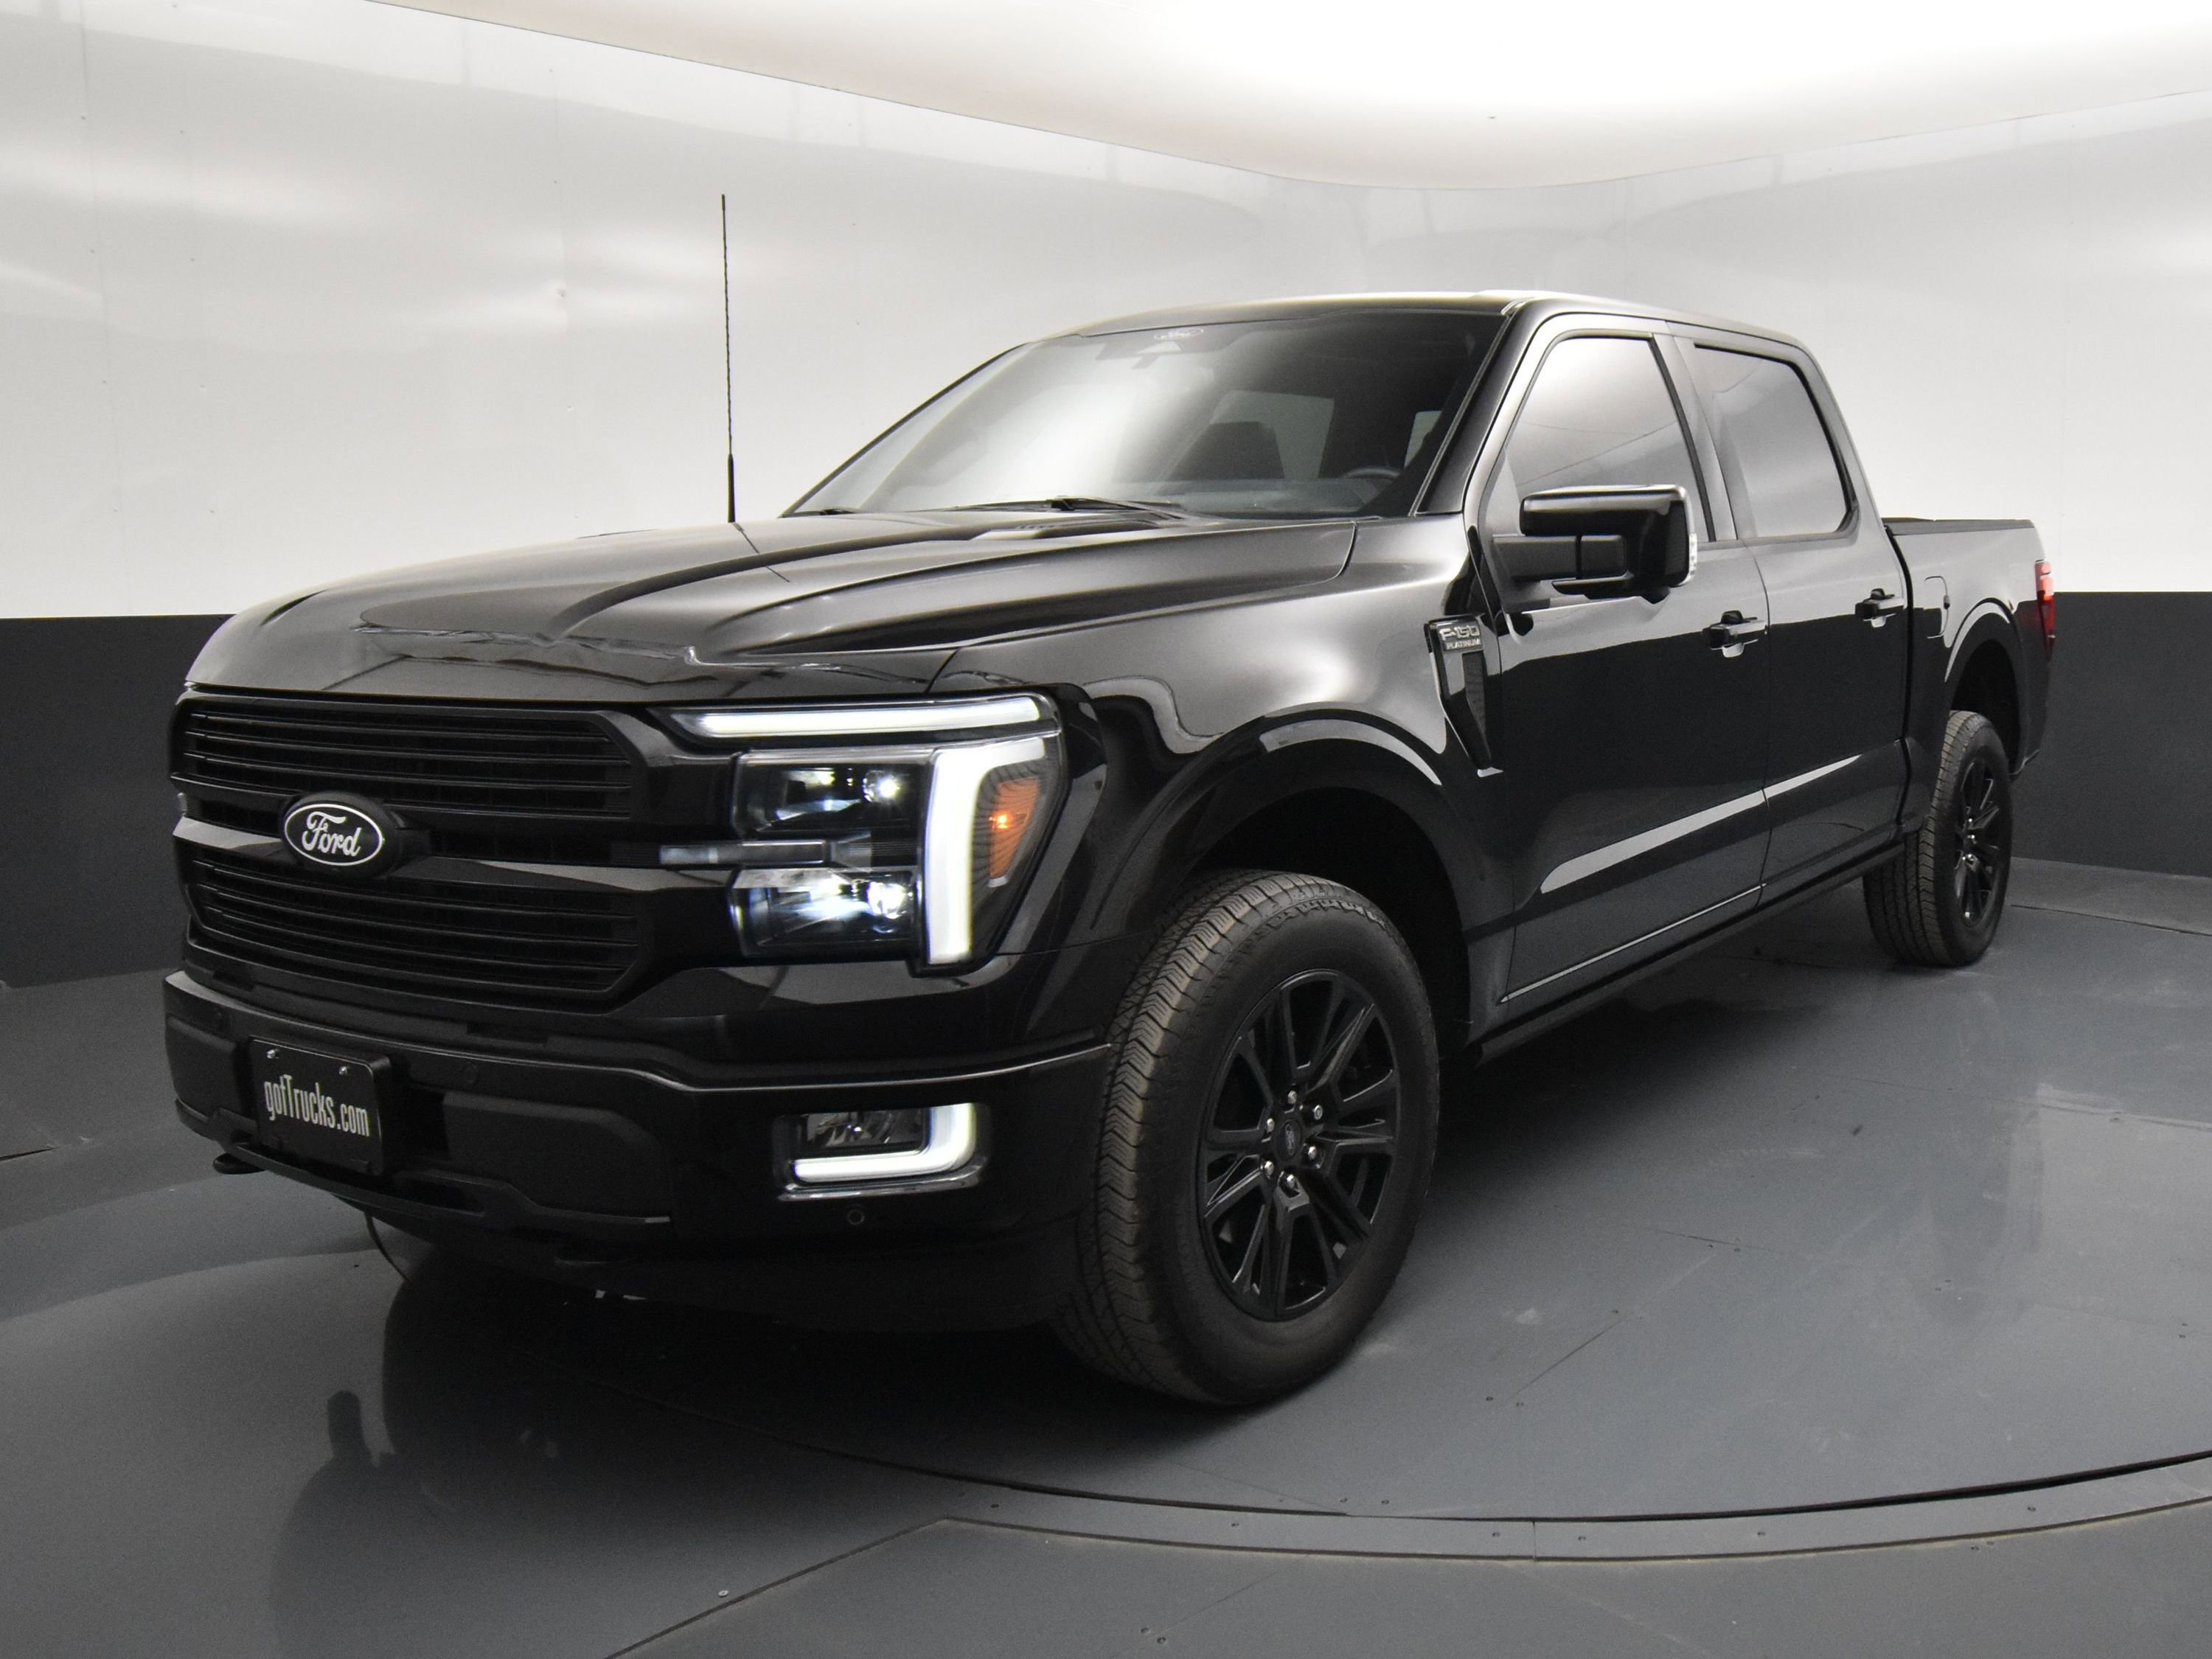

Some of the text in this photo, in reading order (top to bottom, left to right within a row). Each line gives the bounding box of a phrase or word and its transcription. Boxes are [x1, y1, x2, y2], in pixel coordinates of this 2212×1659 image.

[1439, 625, 1481, 641] F-150
[1446, 638, 1481, 650] PLATINUM
[302, 811, 362, 857] Ford
[264, 1074, 369, 1136] gotTrucks.com
